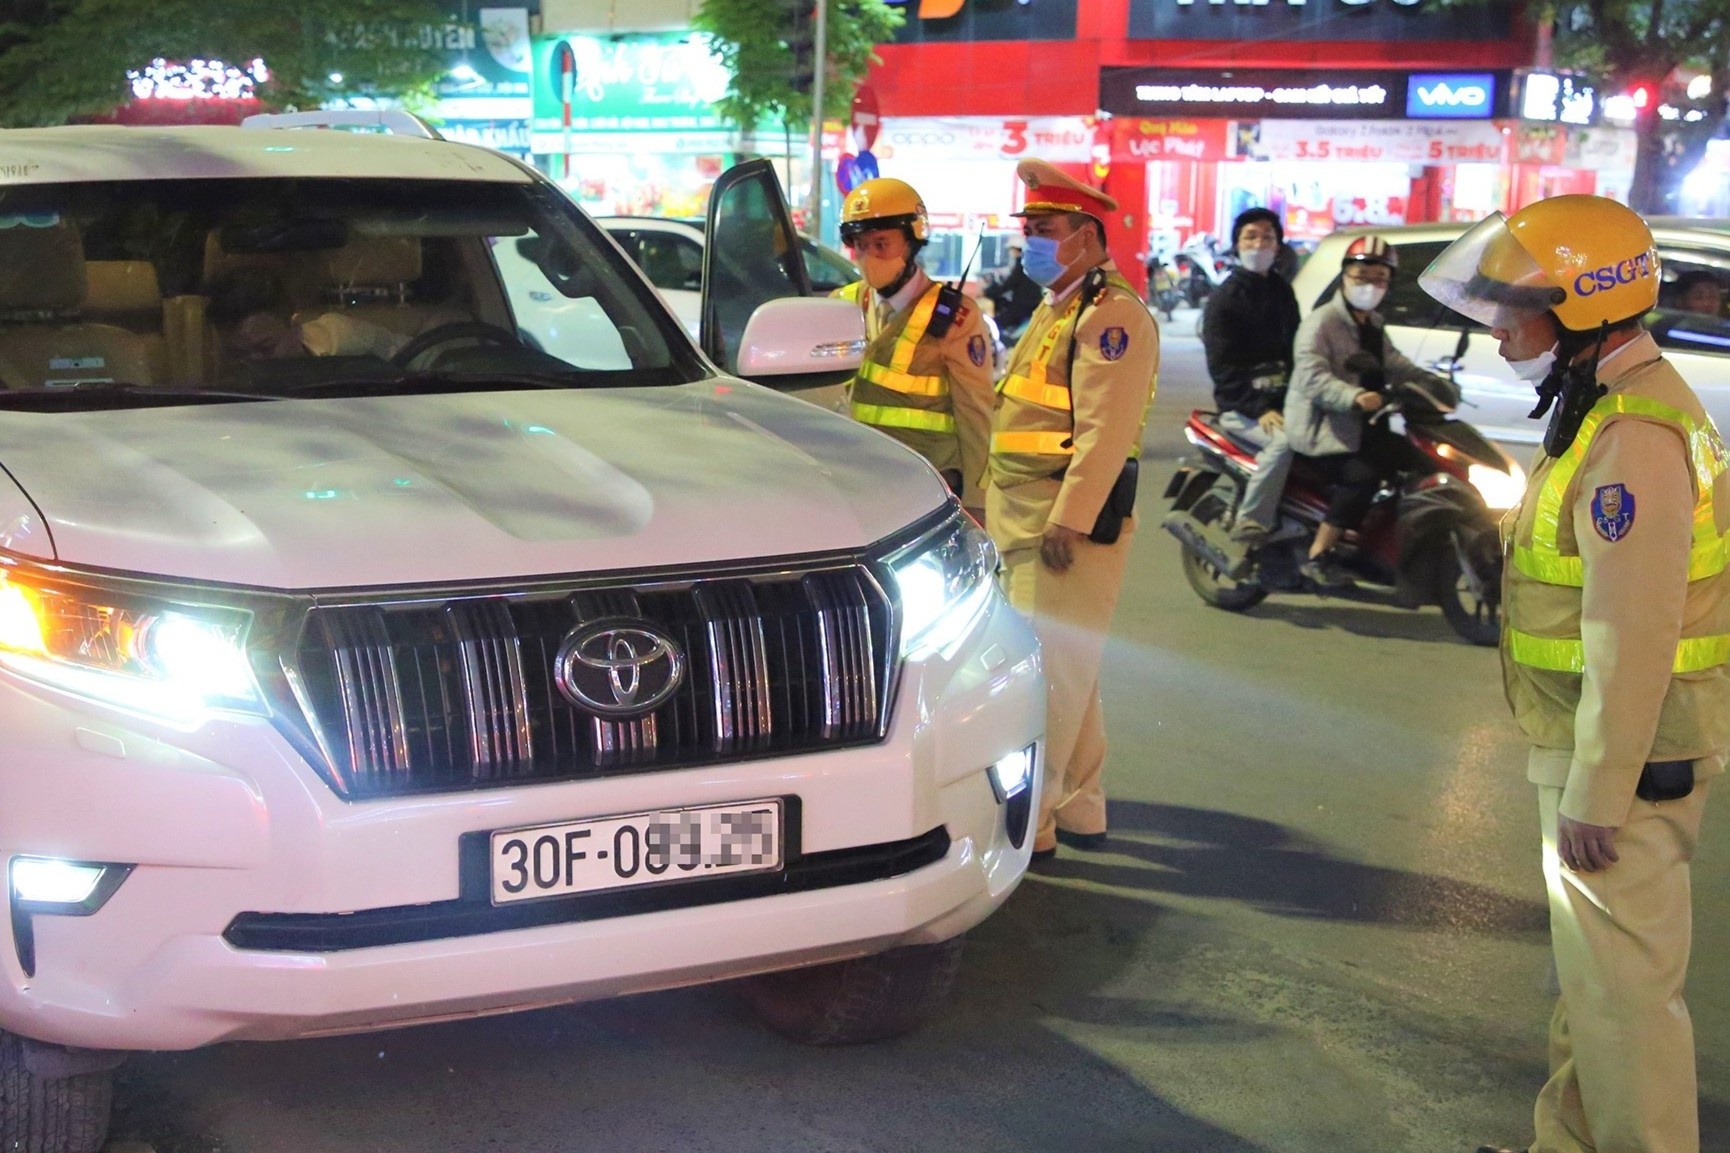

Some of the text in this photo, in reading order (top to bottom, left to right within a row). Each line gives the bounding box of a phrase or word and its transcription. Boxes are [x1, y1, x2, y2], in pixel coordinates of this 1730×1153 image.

[1000, 121, 1027, 154] 3
[1295, 140, 1331, 159] 3.5
[1428, 140, 1443, 159] 5
[1574, 251, 1649, 297] CSGT
